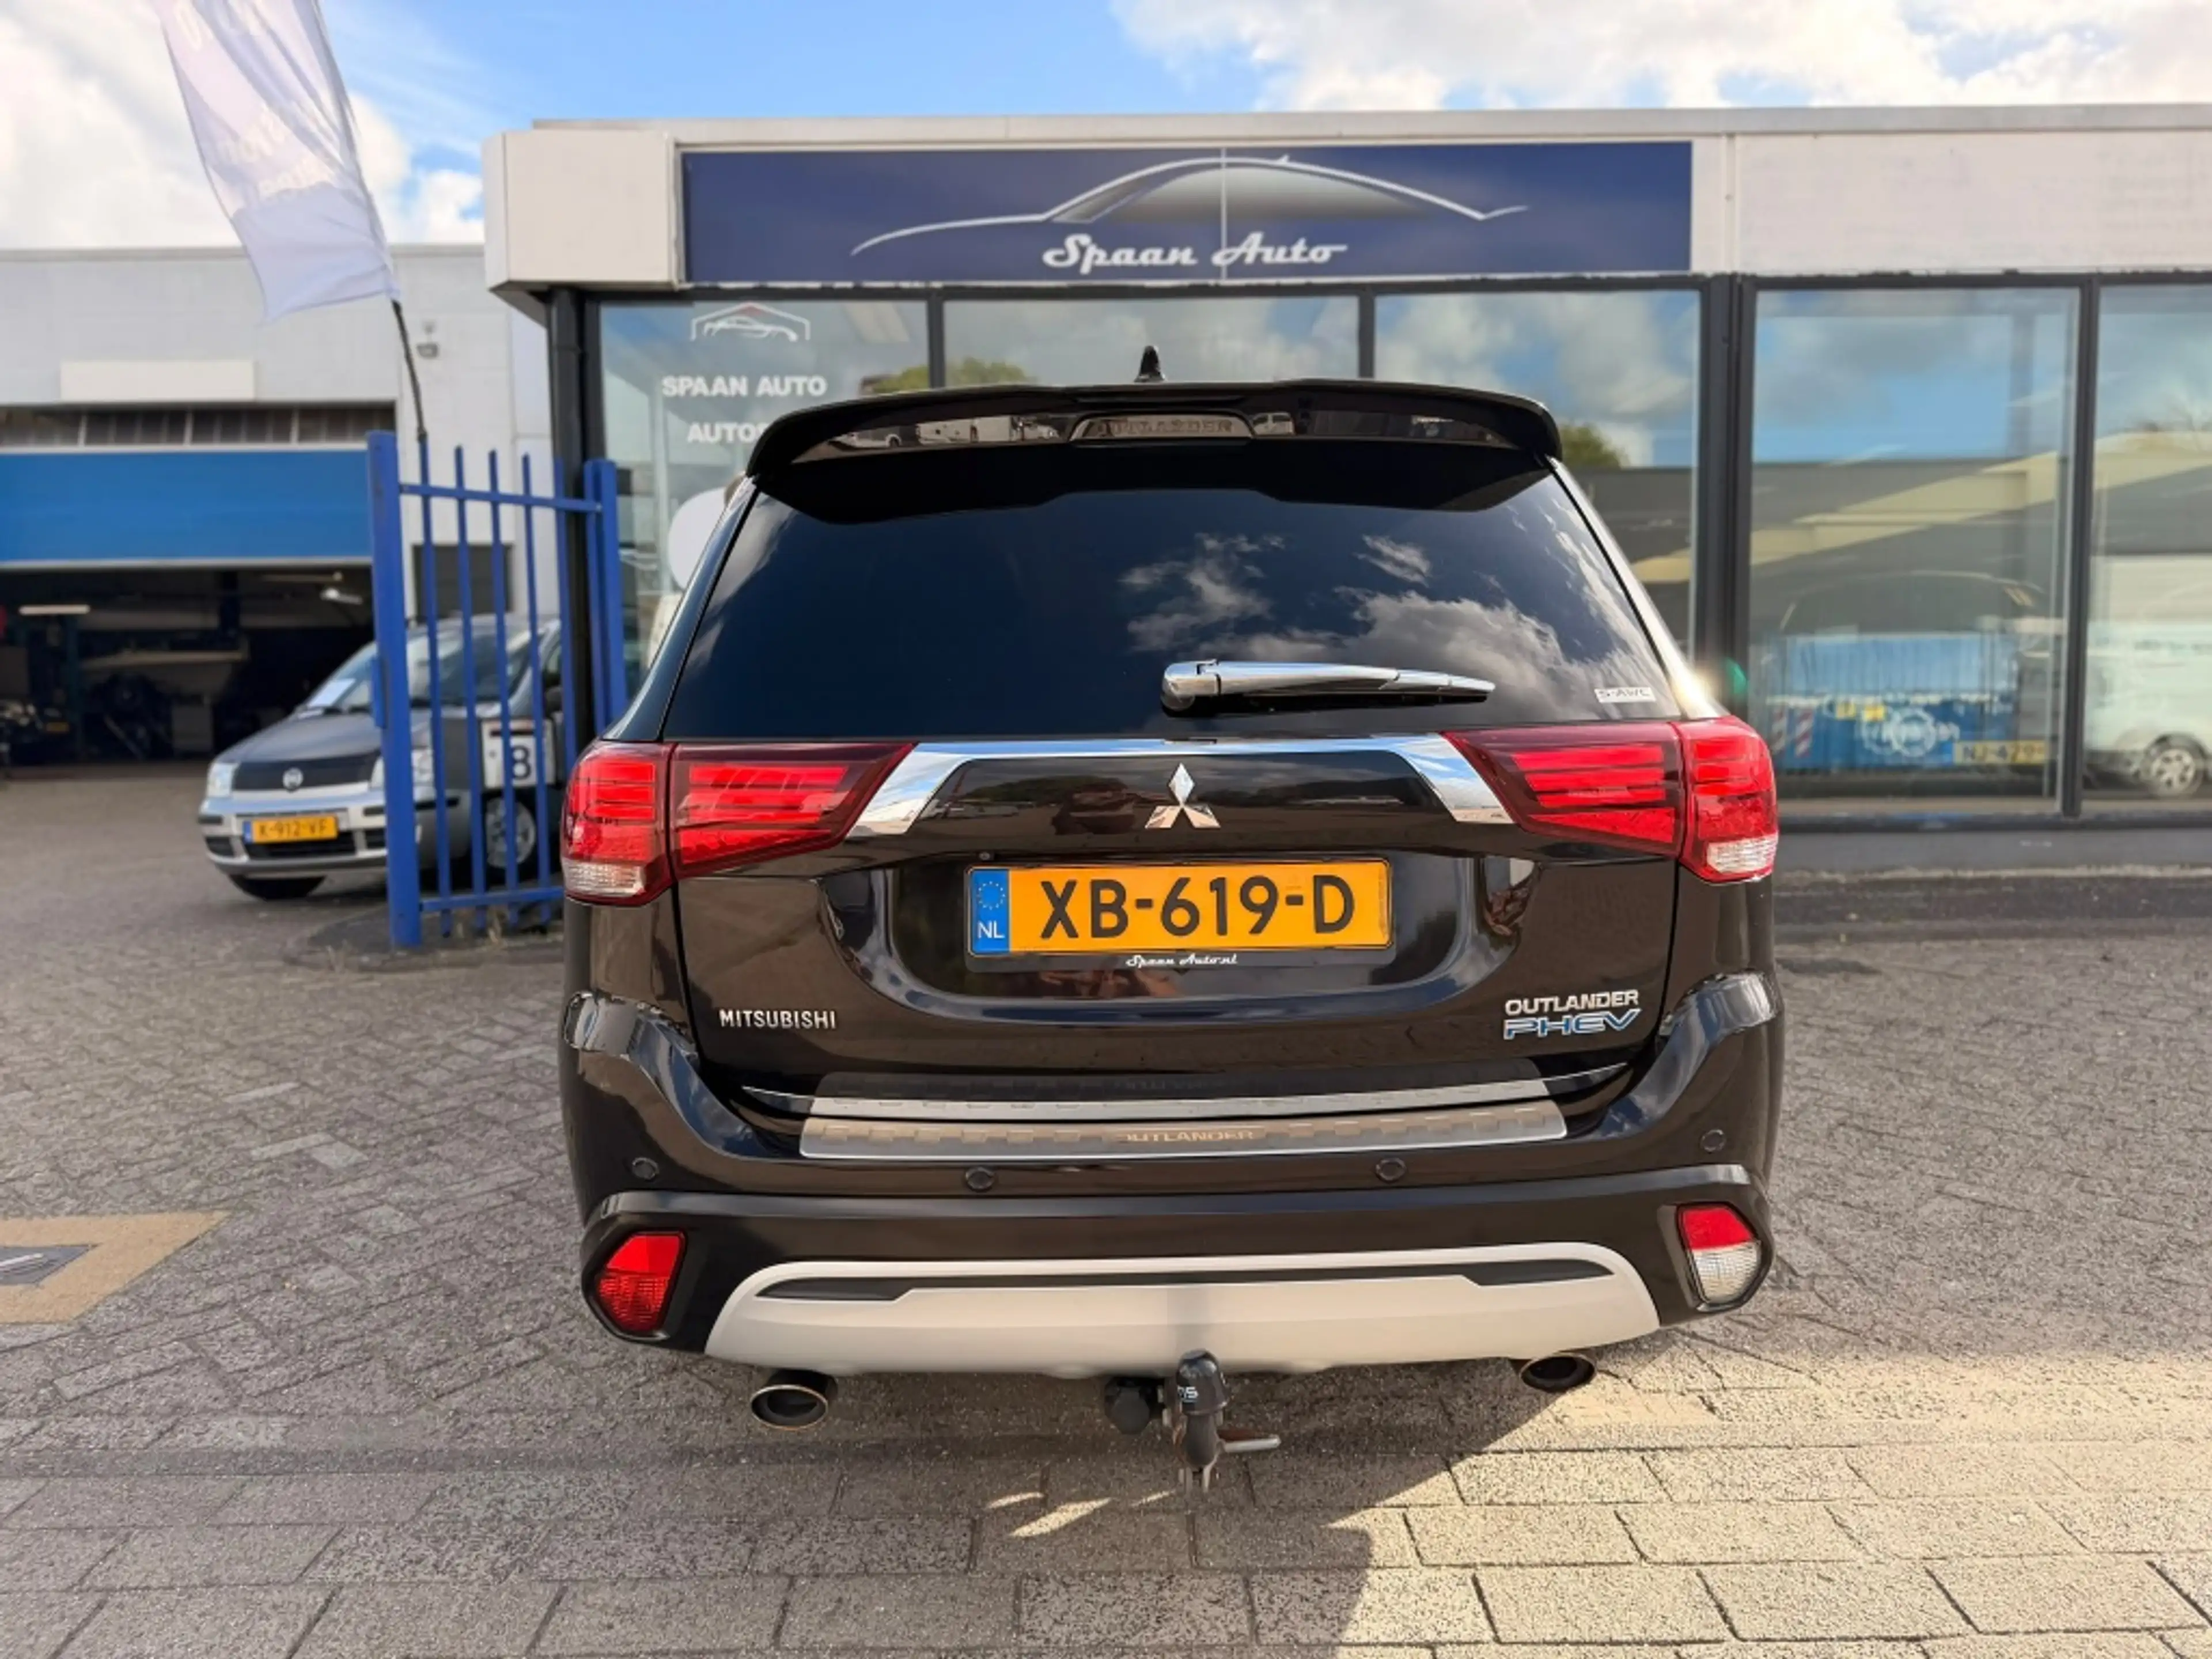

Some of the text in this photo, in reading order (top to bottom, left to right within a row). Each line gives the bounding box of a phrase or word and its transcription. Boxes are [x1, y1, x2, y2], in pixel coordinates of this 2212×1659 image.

[1043, 232, 1348, 275] Spaan Auto
[662, 375, 828, 397] SPAAN AUTO
[978, 874, 1355, 940] NL XB-619-D
[1126, 954, 1175, 969] Spaan
[1505, 989, 1639, 1017] OUTLANDER
[719, 1009, 836, 1029] MITSUBISHI
[1503, 1009, 1642, 1040] PHEV
